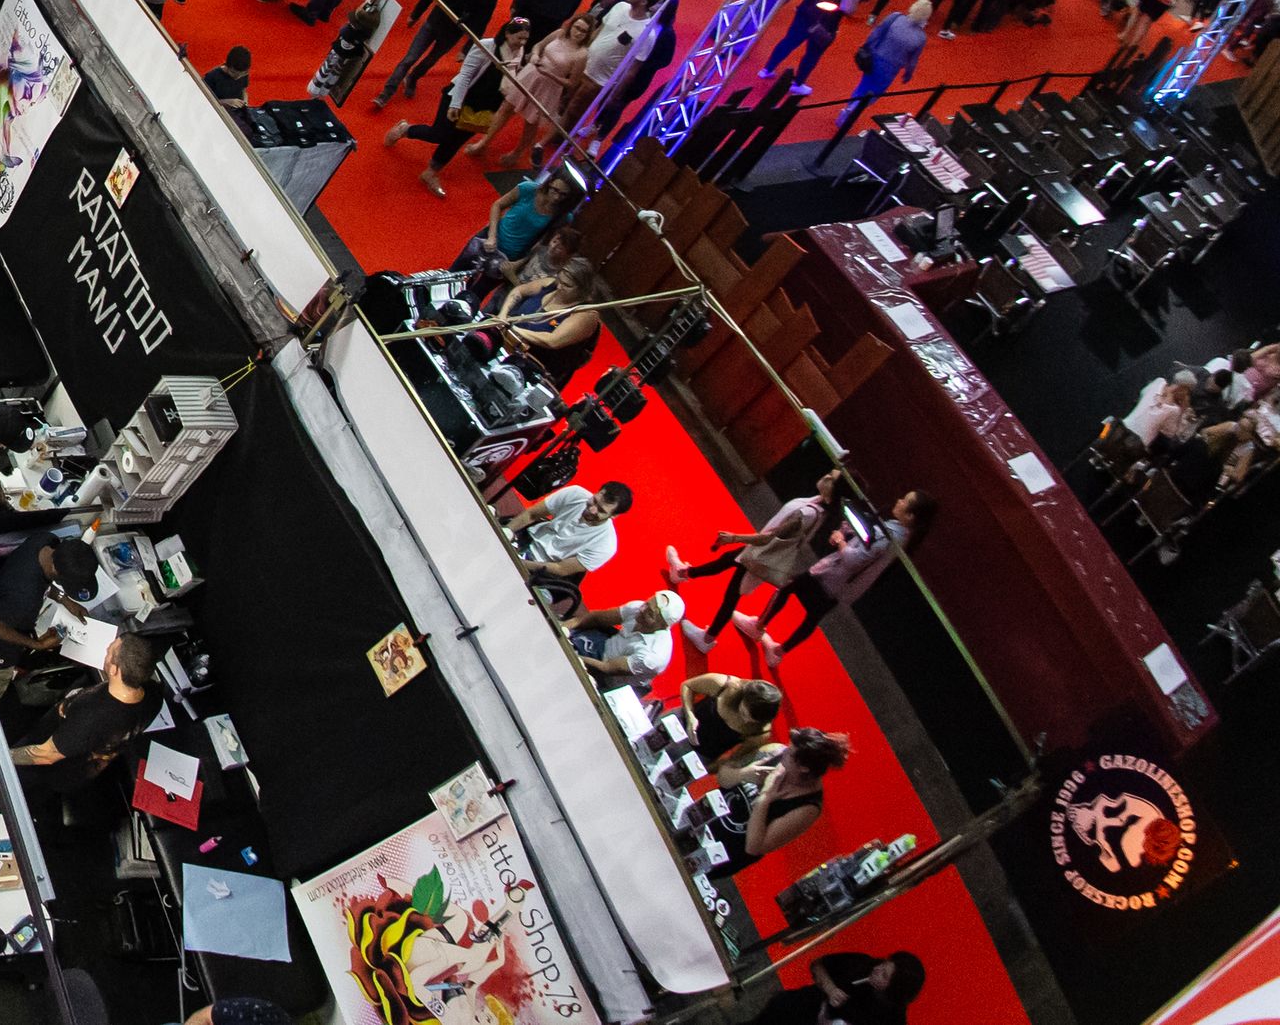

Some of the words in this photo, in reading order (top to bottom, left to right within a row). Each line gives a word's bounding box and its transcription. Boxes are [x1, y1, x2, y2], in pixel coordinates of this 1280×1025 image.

[67, 235, 127, 355] MANU
[68, 166, 173, 356] RATATTOO
[1050, 810, 1072, 867] SINCE
[1064, 869, 1158, 912] ROCKSHOP
[517, 907, 562, 984] Shop
[544, 984, 582, 1019] 78
